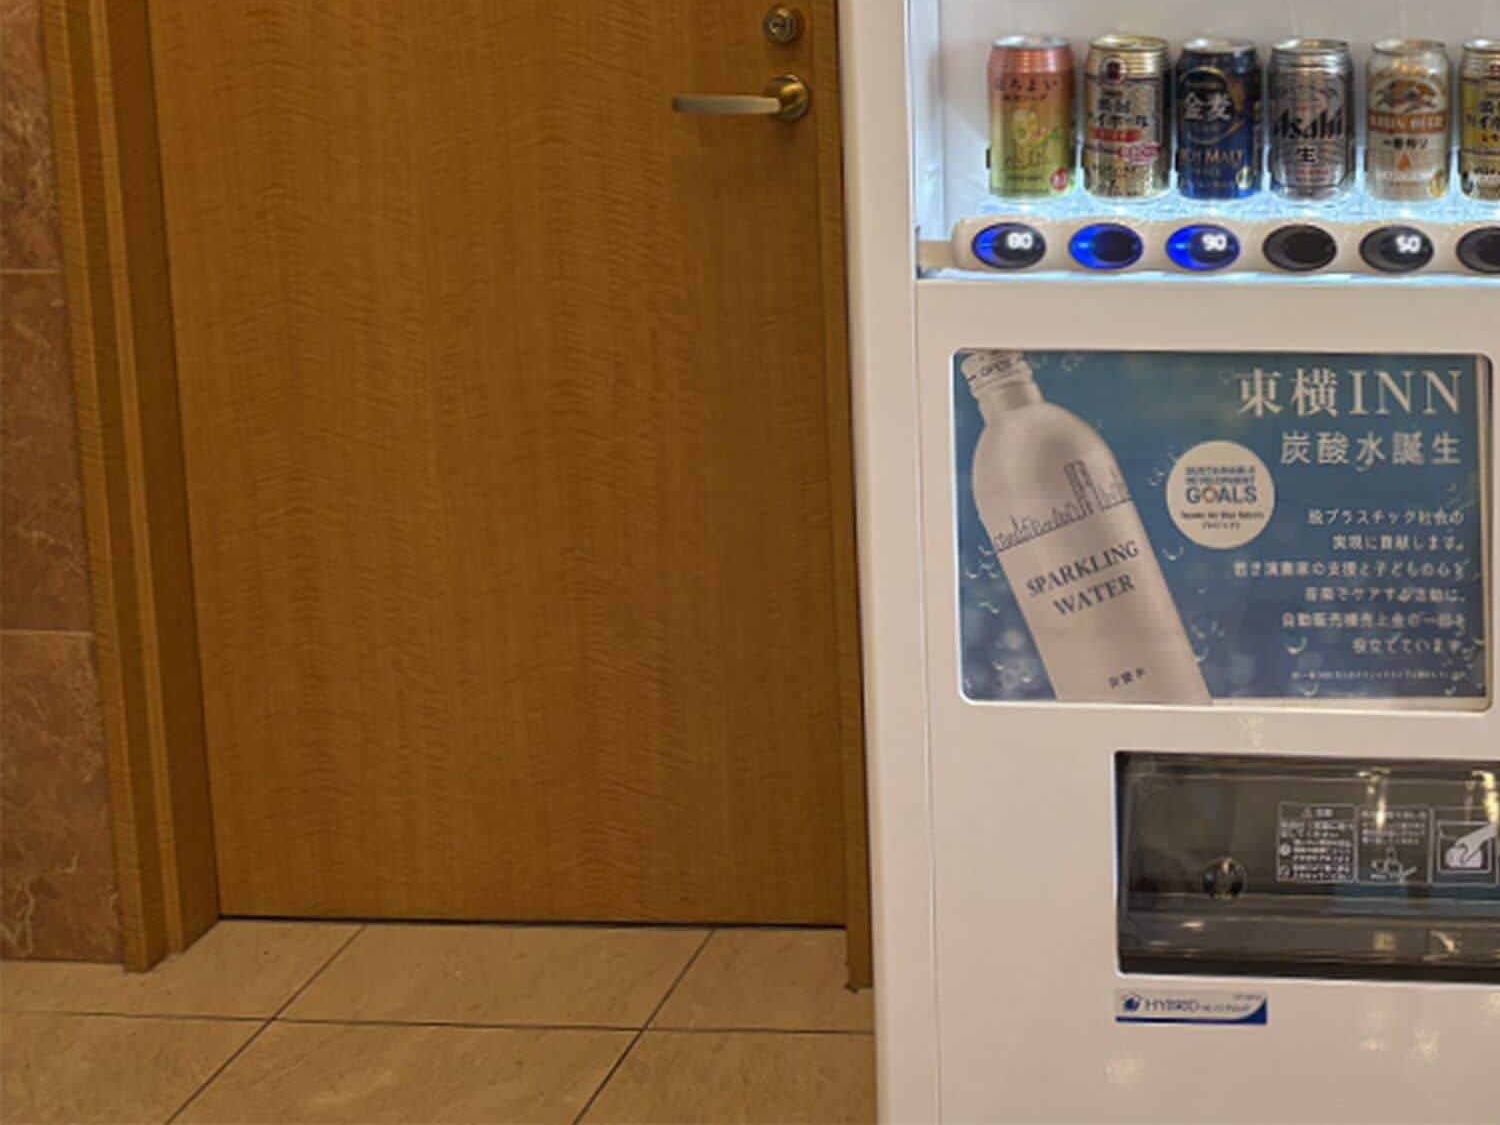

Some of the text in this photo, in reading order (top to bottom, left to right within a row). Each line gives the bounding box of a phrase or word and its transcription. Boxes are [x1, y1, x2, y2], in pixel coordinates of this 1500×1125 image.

[994, 78, 1058, 92] ほろよい
[1184, 92, 1232, 121] 金麦
[1276, 109, 1345, 139] Asahi
[1383, 138, 1428, 149] 一番搾り
[1206, 149, 1243, 164] MALT
[1298, 147, 1317, 162] 生
[1236, 368, 1462, 417] 東横INN
[1281, 431, 1462, 465] 炭酸水誕生
[1186, 485, 1257, 504] GOALS
[1308, 508, 1464, 526] 脱プラスチック社会の
[1332, 534, 1465, 551] 実現に貢献します。
[1026, 540, 1139, 597] SPARKLING
[1053, 573, 1135, 616] WATER
